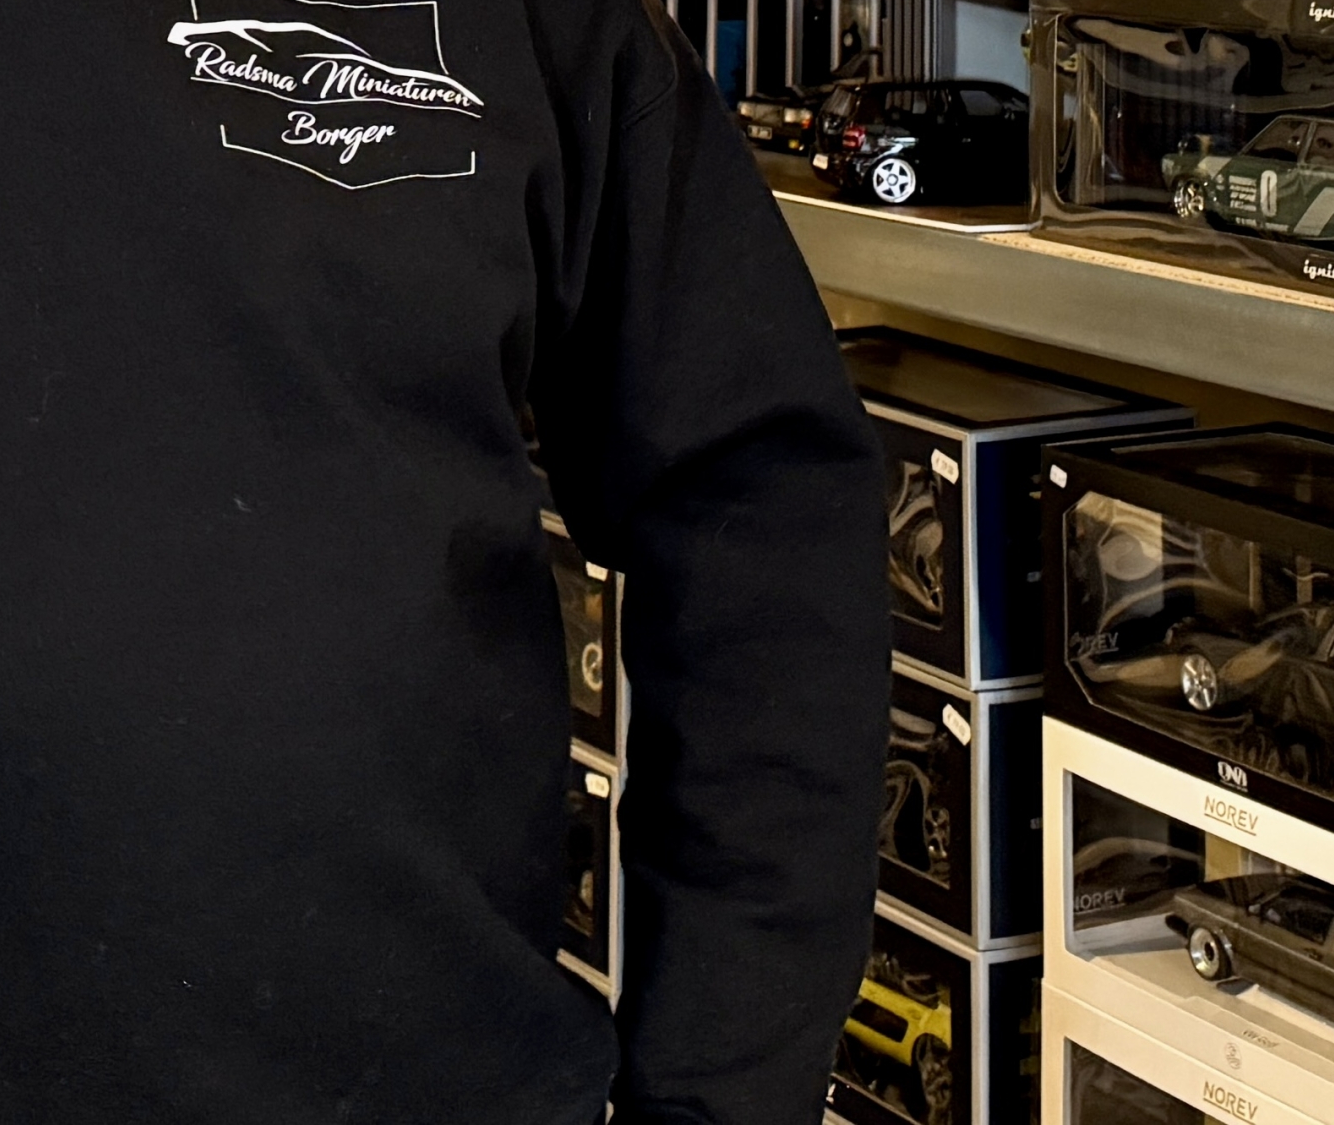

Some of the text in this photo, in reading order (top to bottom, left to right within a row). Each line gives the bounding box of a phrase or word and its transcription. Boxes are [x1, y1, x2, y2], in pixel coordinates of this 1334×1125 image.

[185, 42, 471, 108] Radsma Miniaturen
[281, 111, 396, 164] Borger
[1204, 795, 1259, 836] NOREV
[1203, 1080, 1259, 1125] NOREV
